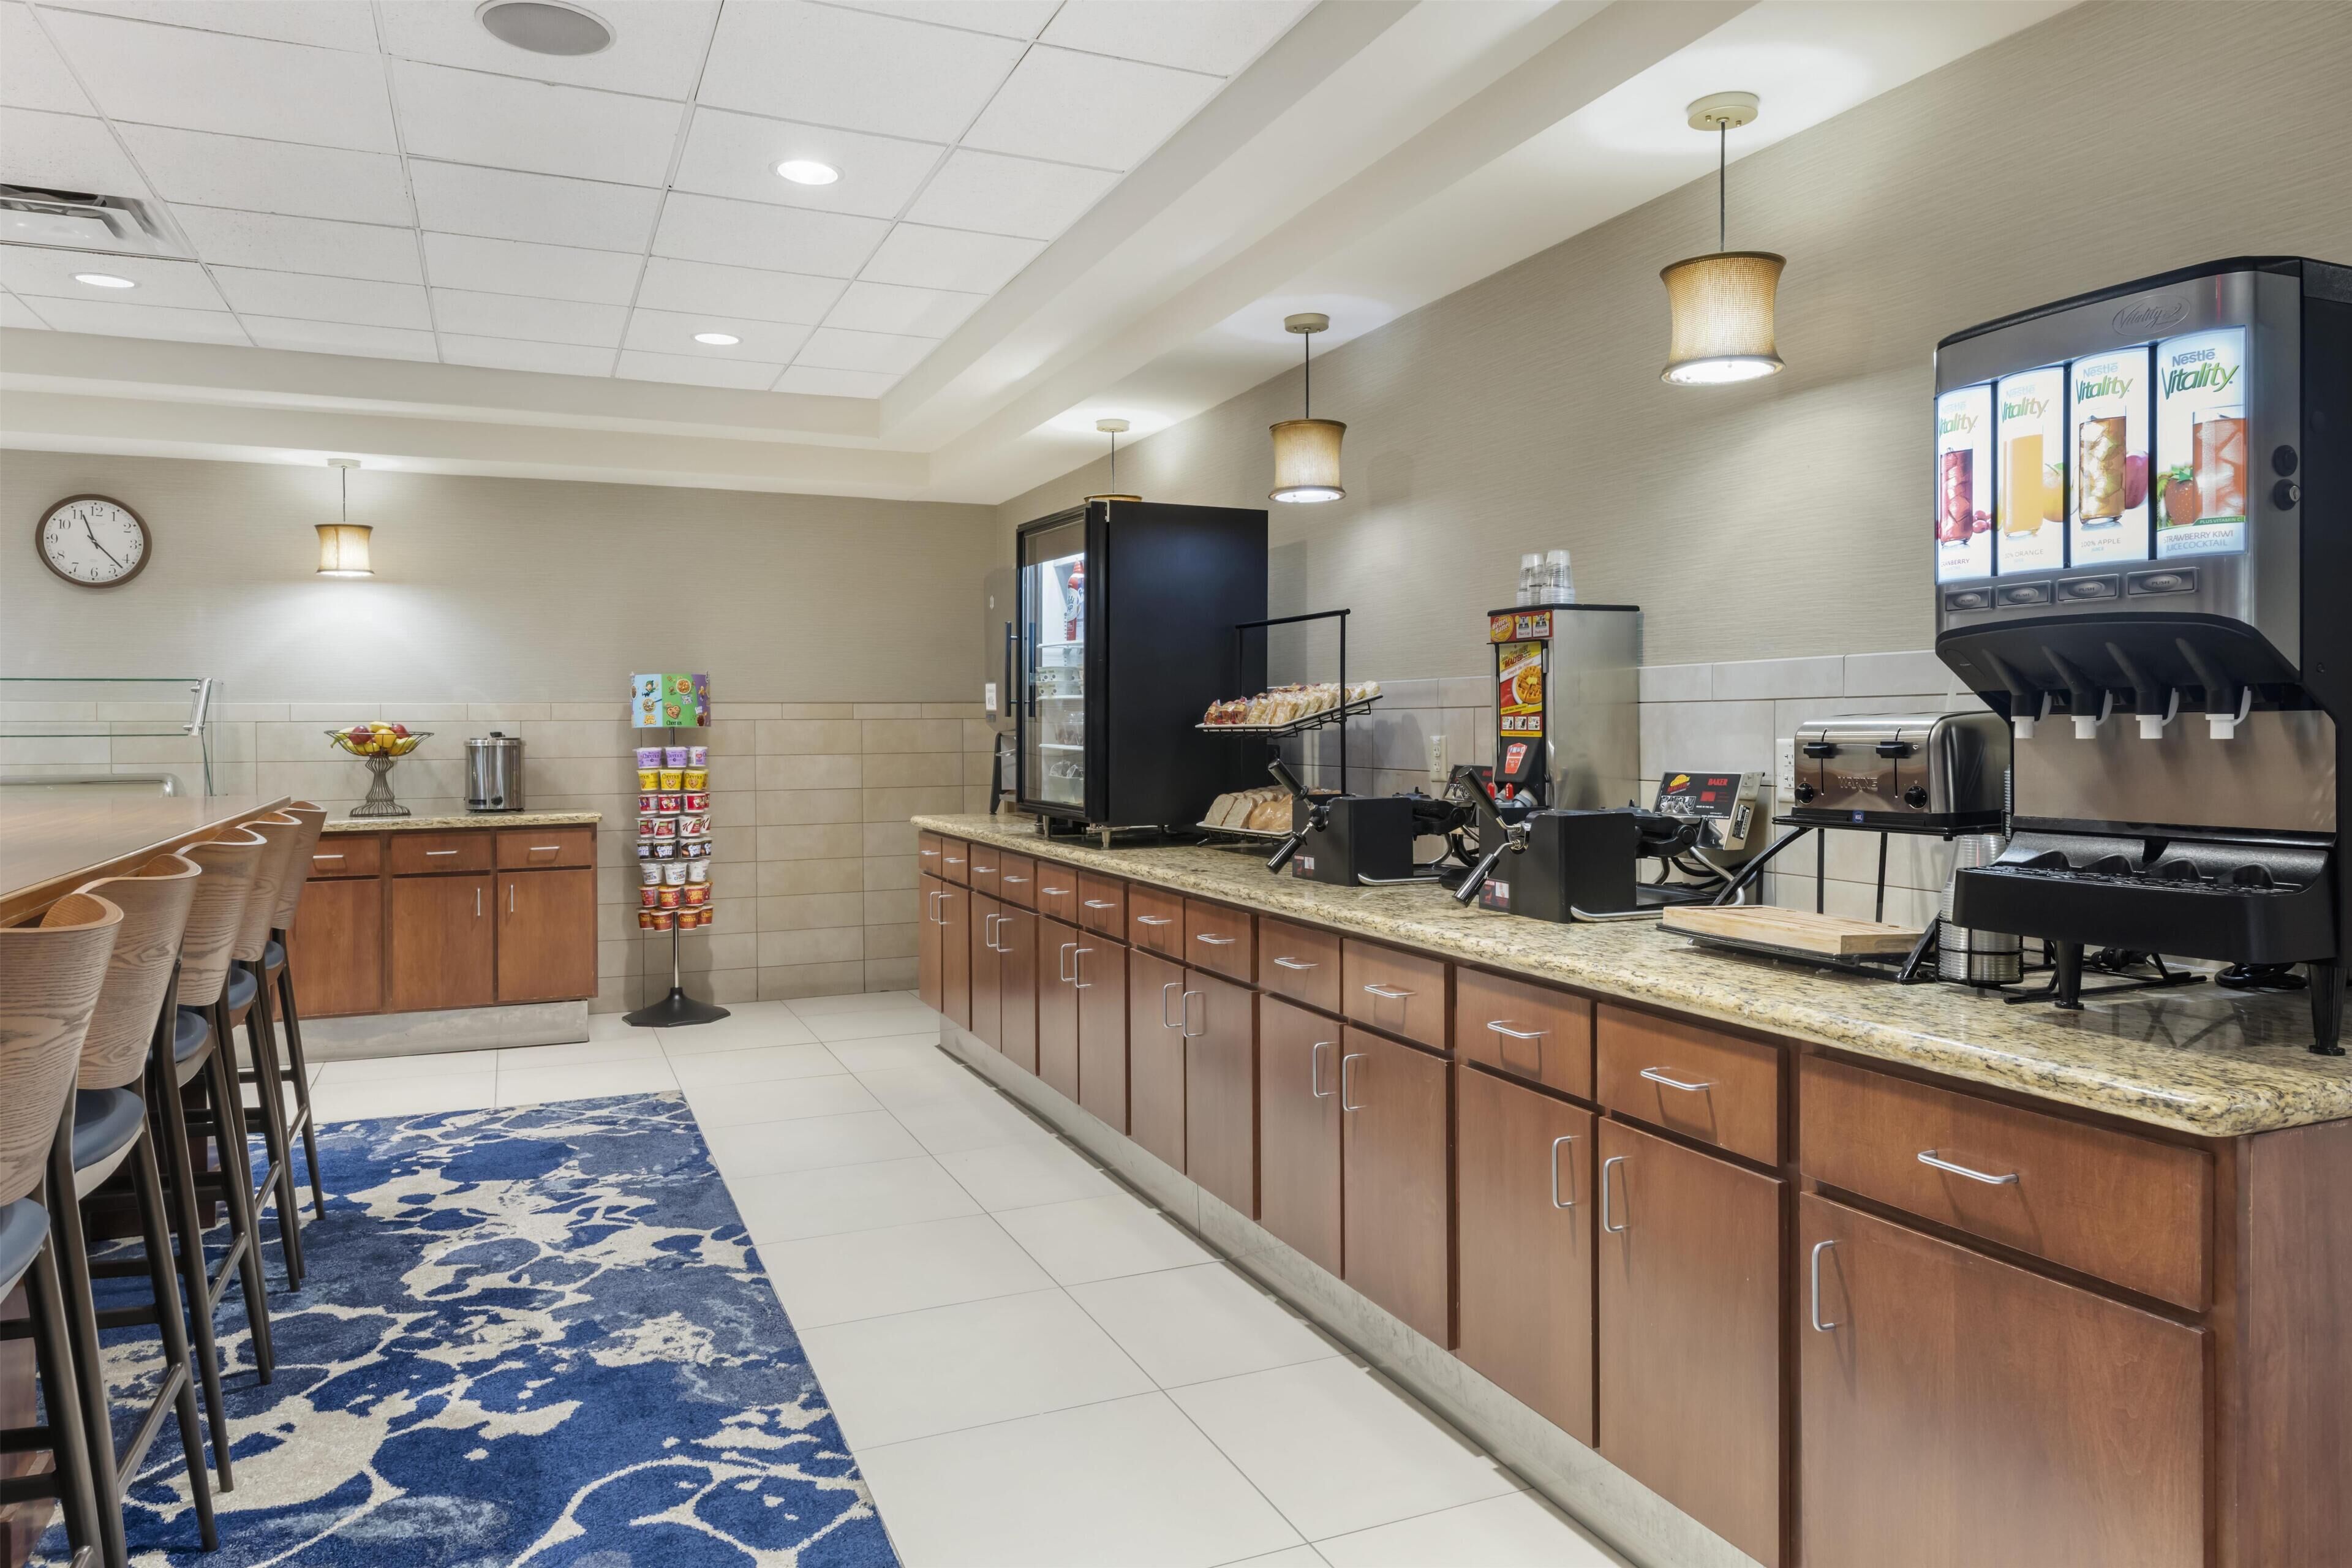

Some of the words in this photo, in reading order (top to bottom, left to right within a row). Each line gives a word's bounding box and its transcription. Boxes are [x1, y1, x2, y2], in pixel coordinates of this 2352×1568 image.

[2162, 362, 2239, 400] Vitality
[2076, 375, 2134, 404] Vitality
[73, 509, 83, 520] 11
[91, 506, 103, 517] 12
[111, 511, 116, 521] 1
[59, 519, 71, 530] 10
[123, 522, 132, 533] 2
[50, 533, 58, 544] 9
[2163, 532, 2210, 543] STRAWBERRY
[130, 539, 138, 549] 3
[2165, 541, 2182, 552] JUICE
[2183, 538, 2228, 550] COCKTAIL
[57, 550, 65, 560] 8
[122, 553, 130, 564] 4
[72, 562, 79, 573] 7
[90, 567, 98, 578] 6
[108, 564, 116, 575] 5
[1708, 778, 1728, 786] BAKER
